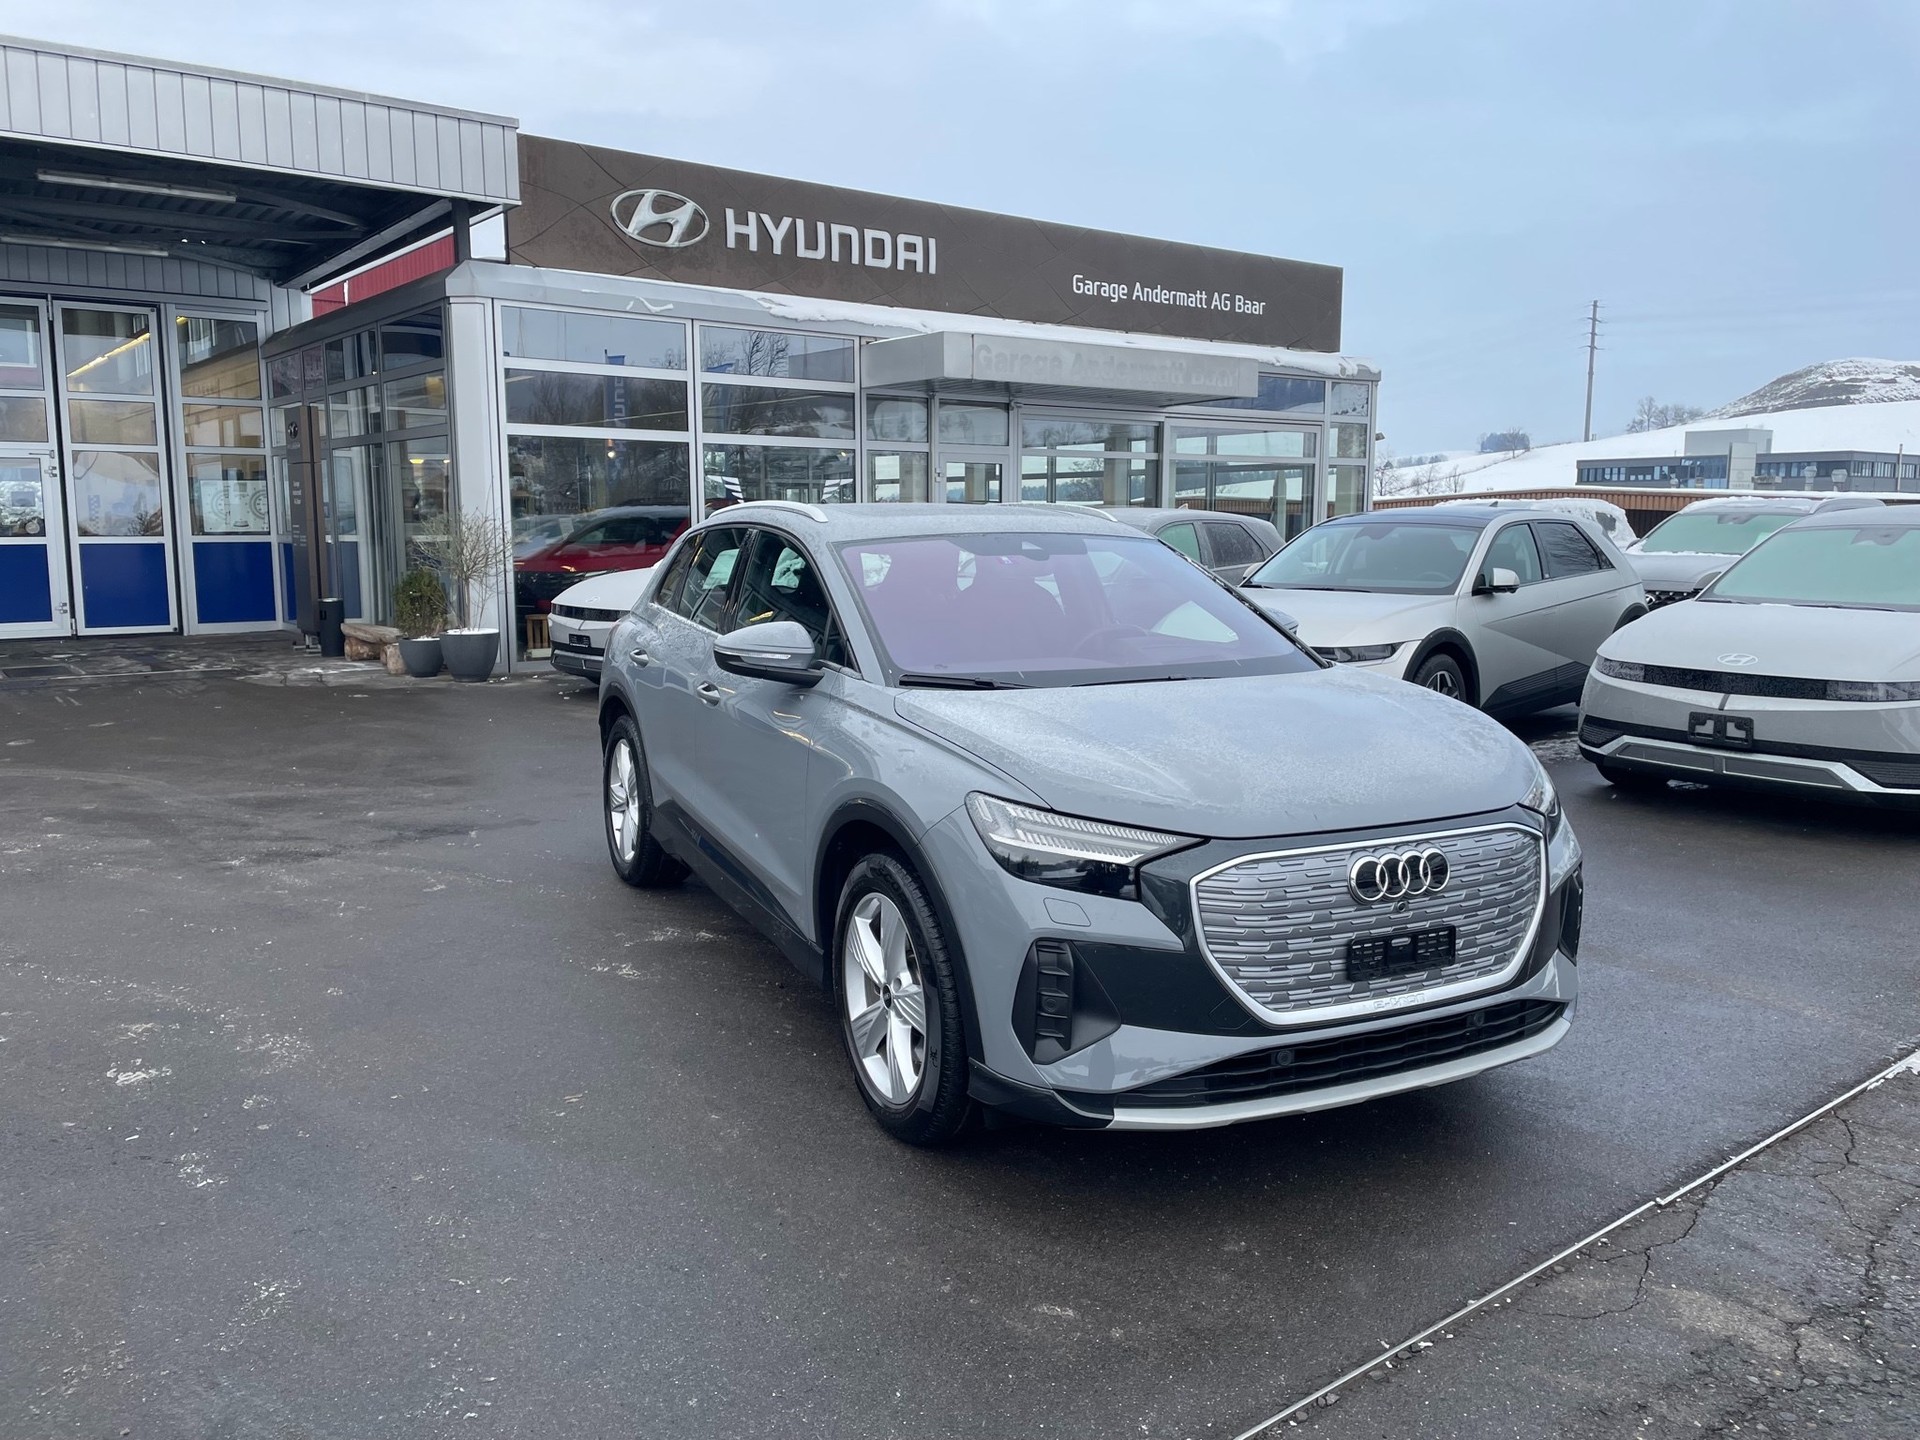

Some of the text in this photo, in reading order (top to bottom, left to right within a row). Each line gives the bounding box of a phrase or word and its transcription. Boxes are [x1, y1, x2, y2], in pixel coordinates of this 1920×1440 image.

[725, 207, 936, 274] HYUNDAI
[1073, 274, 1266, 315] Garage Andermatt AG Baar
